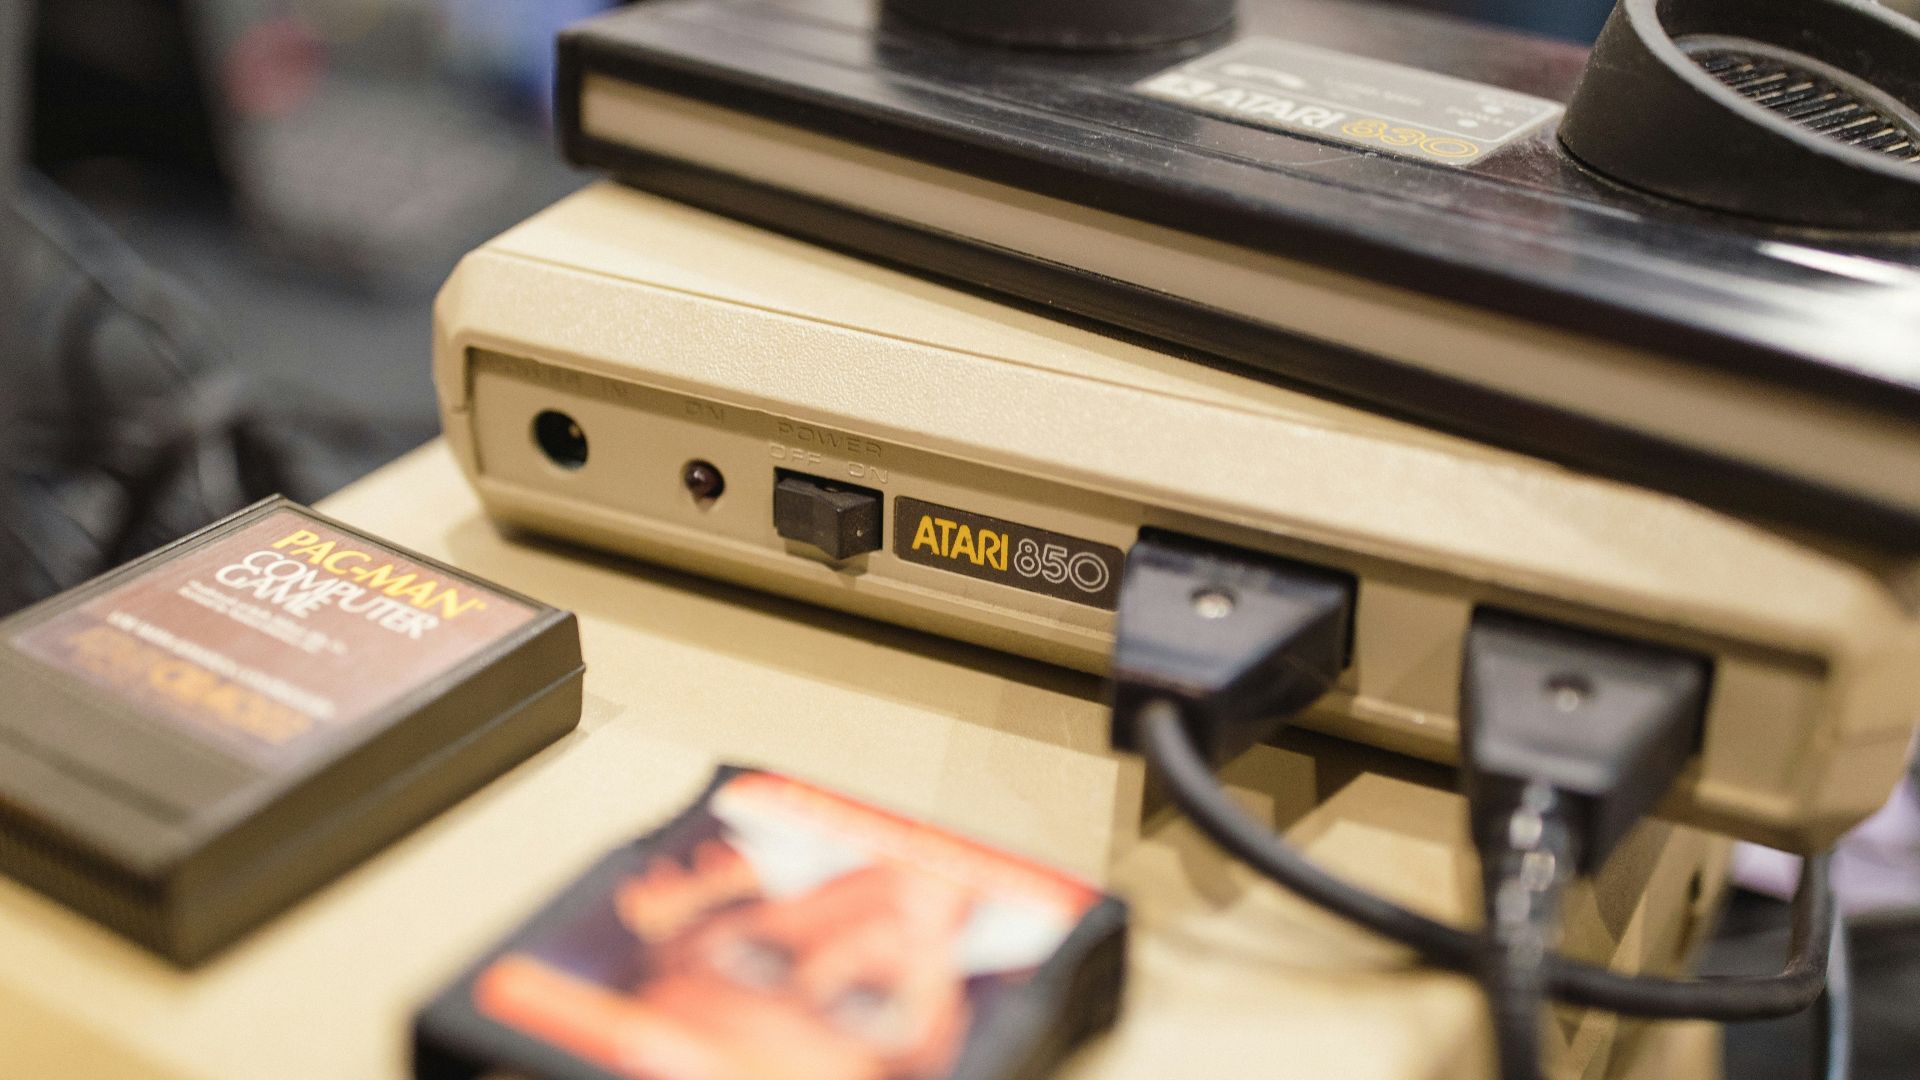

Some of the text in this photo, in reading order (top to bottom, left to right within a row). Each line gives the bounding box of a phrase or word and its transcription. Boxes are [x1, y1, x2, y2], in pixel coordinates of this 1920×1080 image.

[1203, 88, 1348, 130] ATARI
[1342, 118, 1479, 158] 830
[684, 398, 726, 424] ON
[768, 442, 889, 484] OFF ON
[776, 420, 882, 459] POWER
[912, 515, 1110, 592] ATARI 850
[215, 563, 331, 619] GAME
[242, 550, 440, 640] COMPUTER
